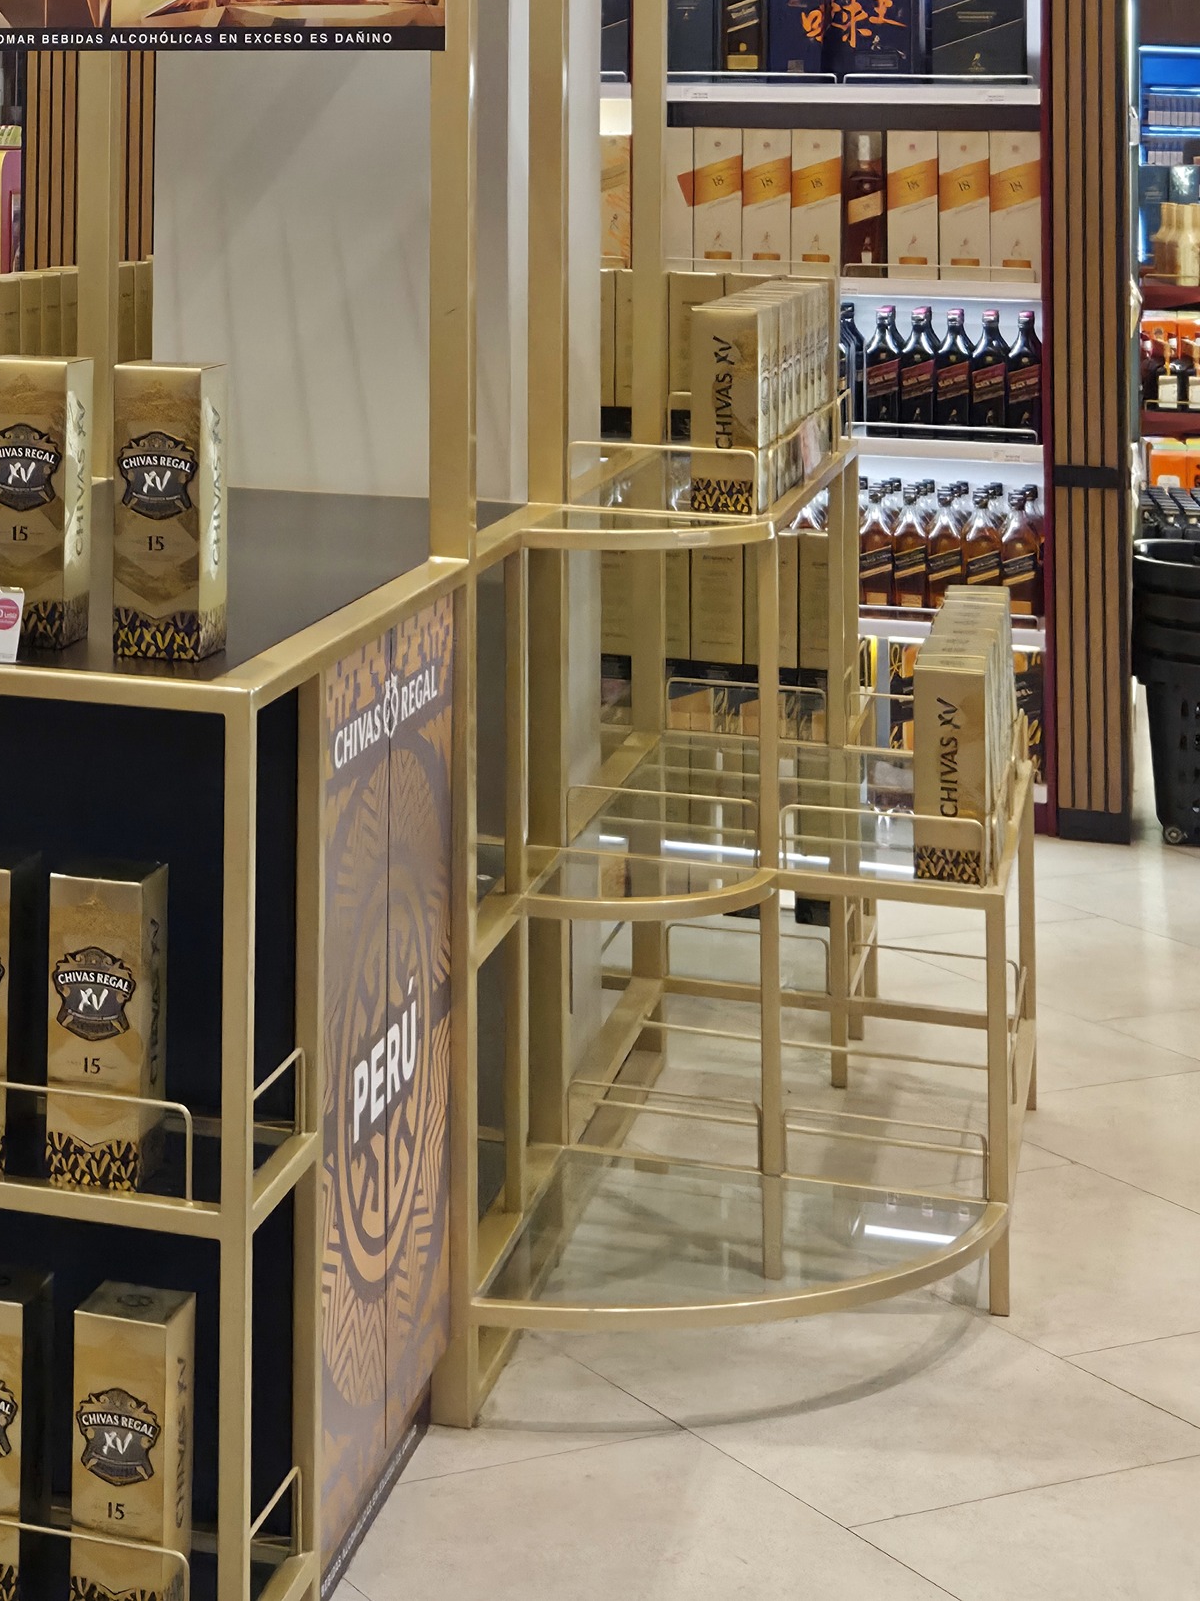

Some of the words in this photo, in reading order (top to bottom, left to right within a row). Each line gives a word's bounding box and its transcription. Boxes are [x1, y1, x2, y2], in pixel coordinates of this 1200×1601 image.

[41, 33, 104, 45] BEBIDAS
[110, 31, 213, 44] ALCOHÓLICAS
[219, 33, 238, 44] EN
[244, 32, 303, 44] EXCESO
[310, 33, 327, 44] ES
[334, 29, 393, 44] DAÑINO
[715, 372, 733, 449] CHIVAS
[25, 447, 55, 465] REGAL
[122, 455, 158, 469] CHIVAS
[160, 455, 191, 473] REGAL
[8, 461, 36, 485] XV
[143, 469, 171, 493] XV
[12, 525, 28, 542] 15
[149, 535, 164, 552] 15
[334, 703, 381, 769] CHIVAS
[401, 665, 437, 721] REGAL
[936, 697, 961, 729] XV
[940, 736, 958, 818] CHIVAS
[58, 972, 95, 985] CHIVAS
[97, 973, 130, 992] REGAL
[78, 988, 109, 1012] XV
[84, 1057, 100, 1074] 15
[353, 976, 416, 1144] PERÚ
[82, 1414, 119, 1426] CHIVAS
[120, 1416, 153, 1438] REGAL
[102, 1431, 133, 1455] XV
[107, 1501, 125, 1520] 15
